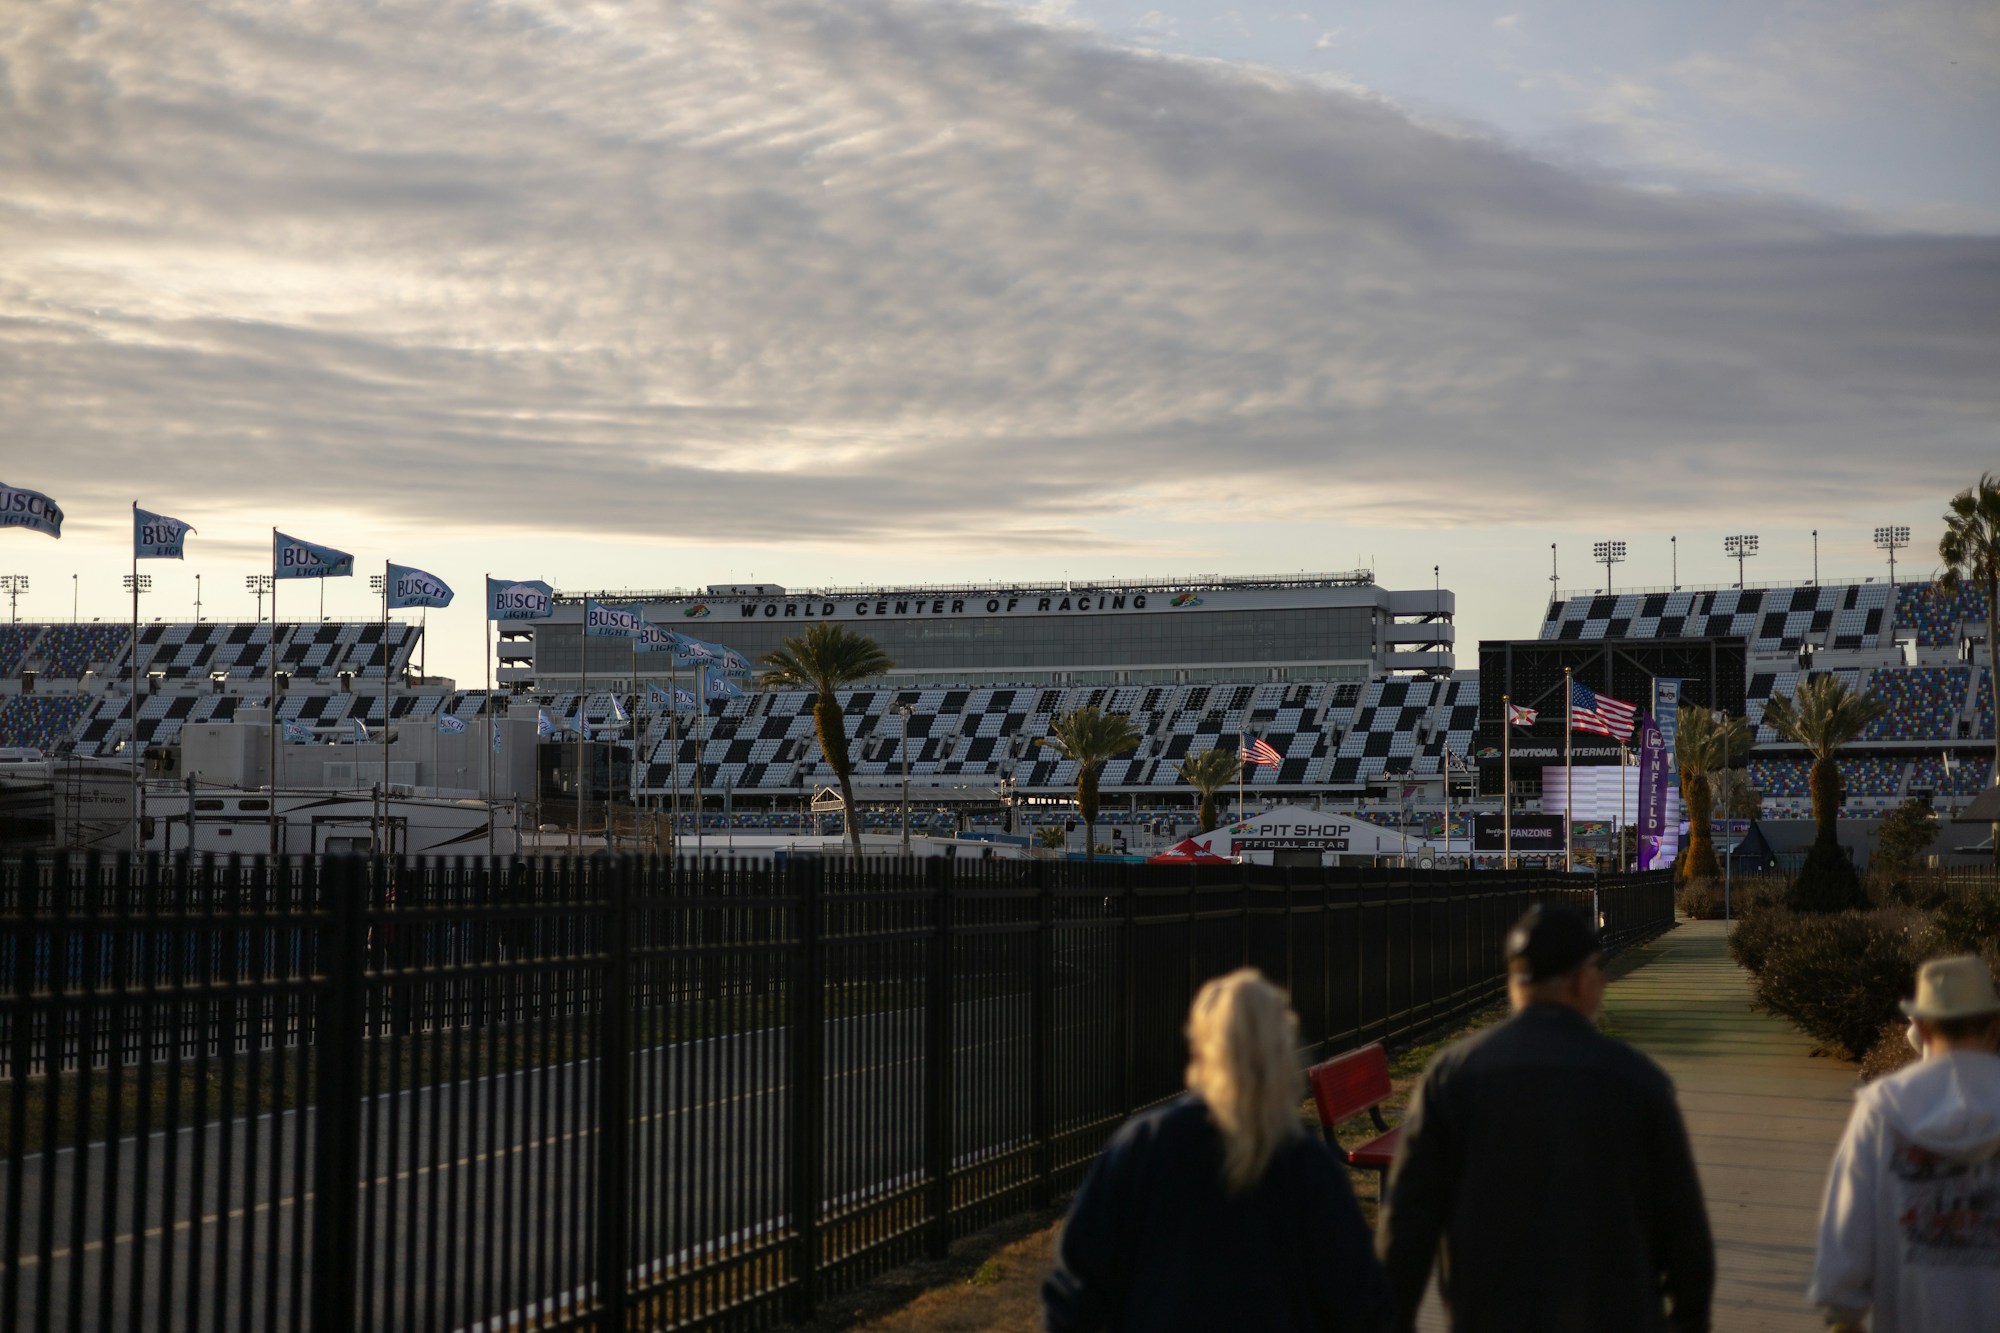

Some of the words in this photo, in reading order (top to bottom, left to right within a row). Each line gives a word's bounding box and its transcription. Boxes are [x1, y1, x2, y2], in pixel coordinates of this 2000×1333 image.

[0, 492, 57, 523] USCH
[3, 515, 41, 528] IGHT
[142, 525, 182, 546] BUS
[396, 578, 446, 599] BUSCH
[495, 593, 547, 611] BUSCH
[740, 603, 836, 617] WORLD
[856, 599, 965, 615] CENTER
[986, 598, 1018, 613] OF
[1038, 595, 1148, 612] RACING
[503, 610, 536, 619] LIGHT
[589, 611, 640, 630] BUSCH
[598, 627, 629, 637] LIGHT
[640, 629, 675, 644] BUS
[1509, 748, 1558, 757] DAYTONA
[1648, 749, 1661, 829] INFIELD
[101, 796, 126, 804] RIVER
[1260, 824, 1291, 836] PIT
[1294, 824, 1351, 836] SHOP
[1510, 828, 1552, 838] FANZONE
[1307, 841, 1345, 849] GEAR
